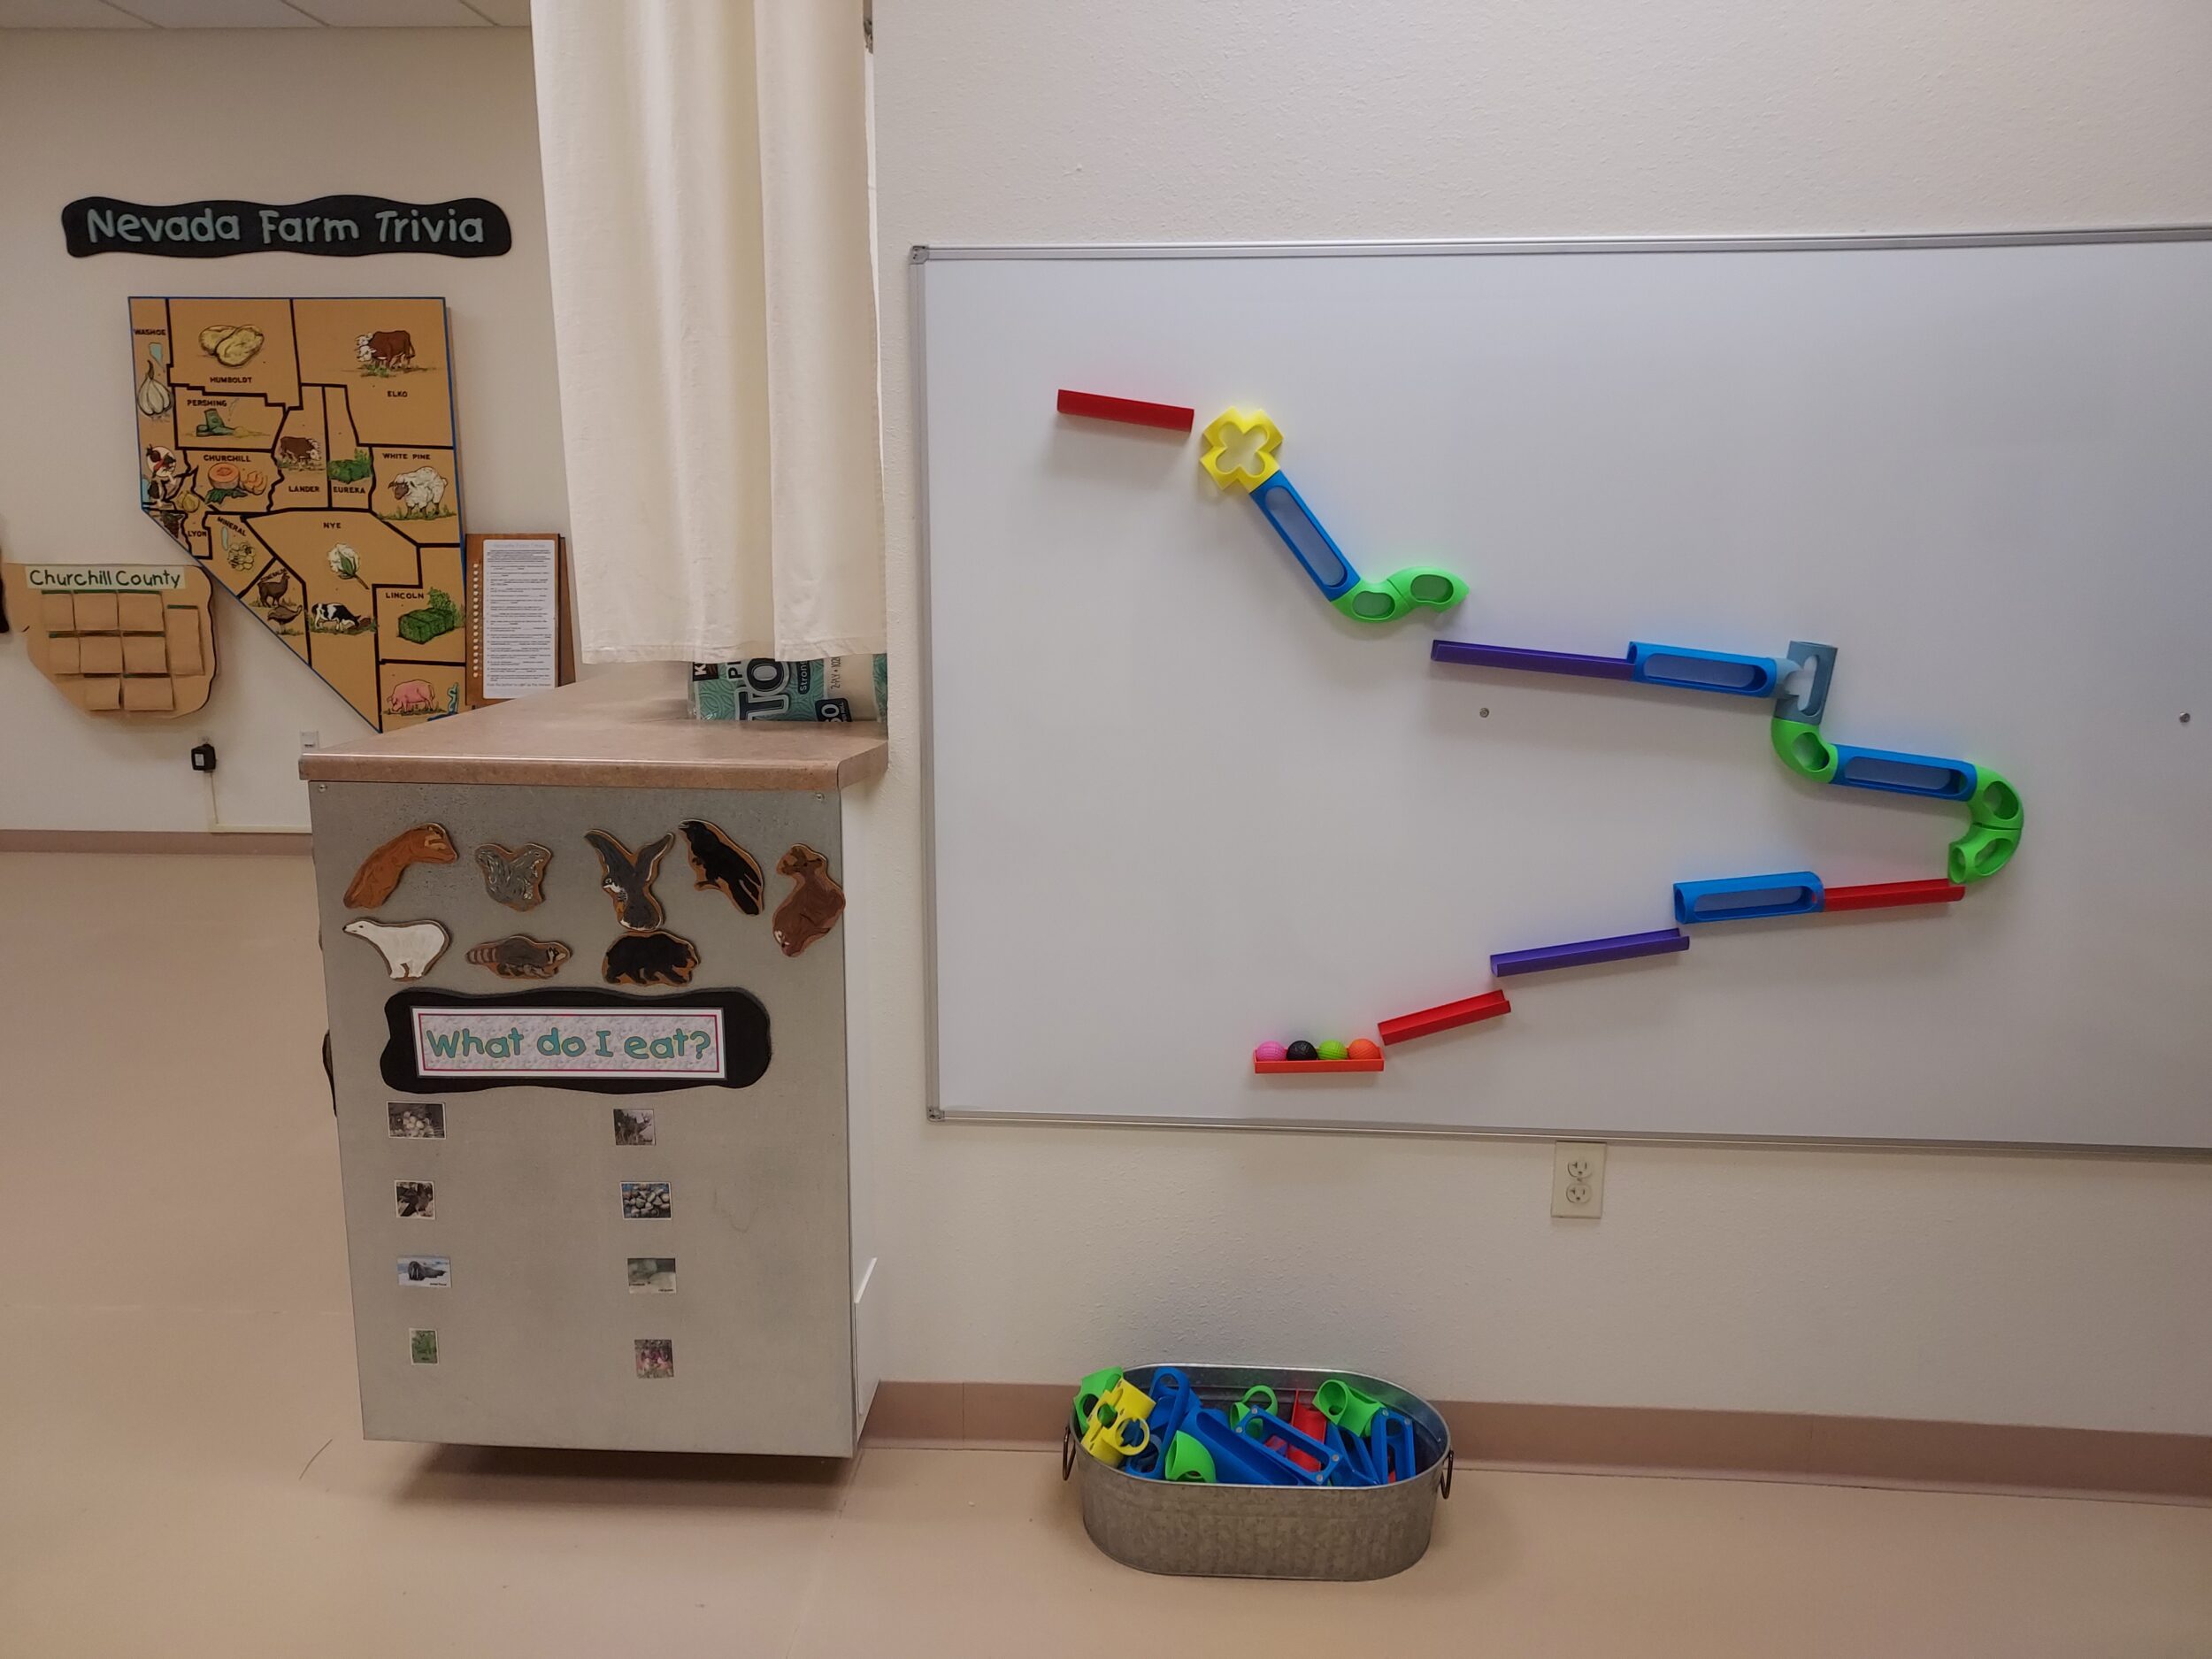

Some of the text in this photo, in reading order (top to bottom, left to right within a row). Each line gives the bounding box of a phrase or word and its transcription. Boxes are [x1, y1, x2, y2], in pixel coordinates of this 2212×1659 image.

[87, 207, 485, 244] Nevada Farm Trivia
[217, 516, 248, 537] MINERAL
[29, 569, 180, 588] Churchill County
[426, 1027, 711, 1060] What do I eat?
